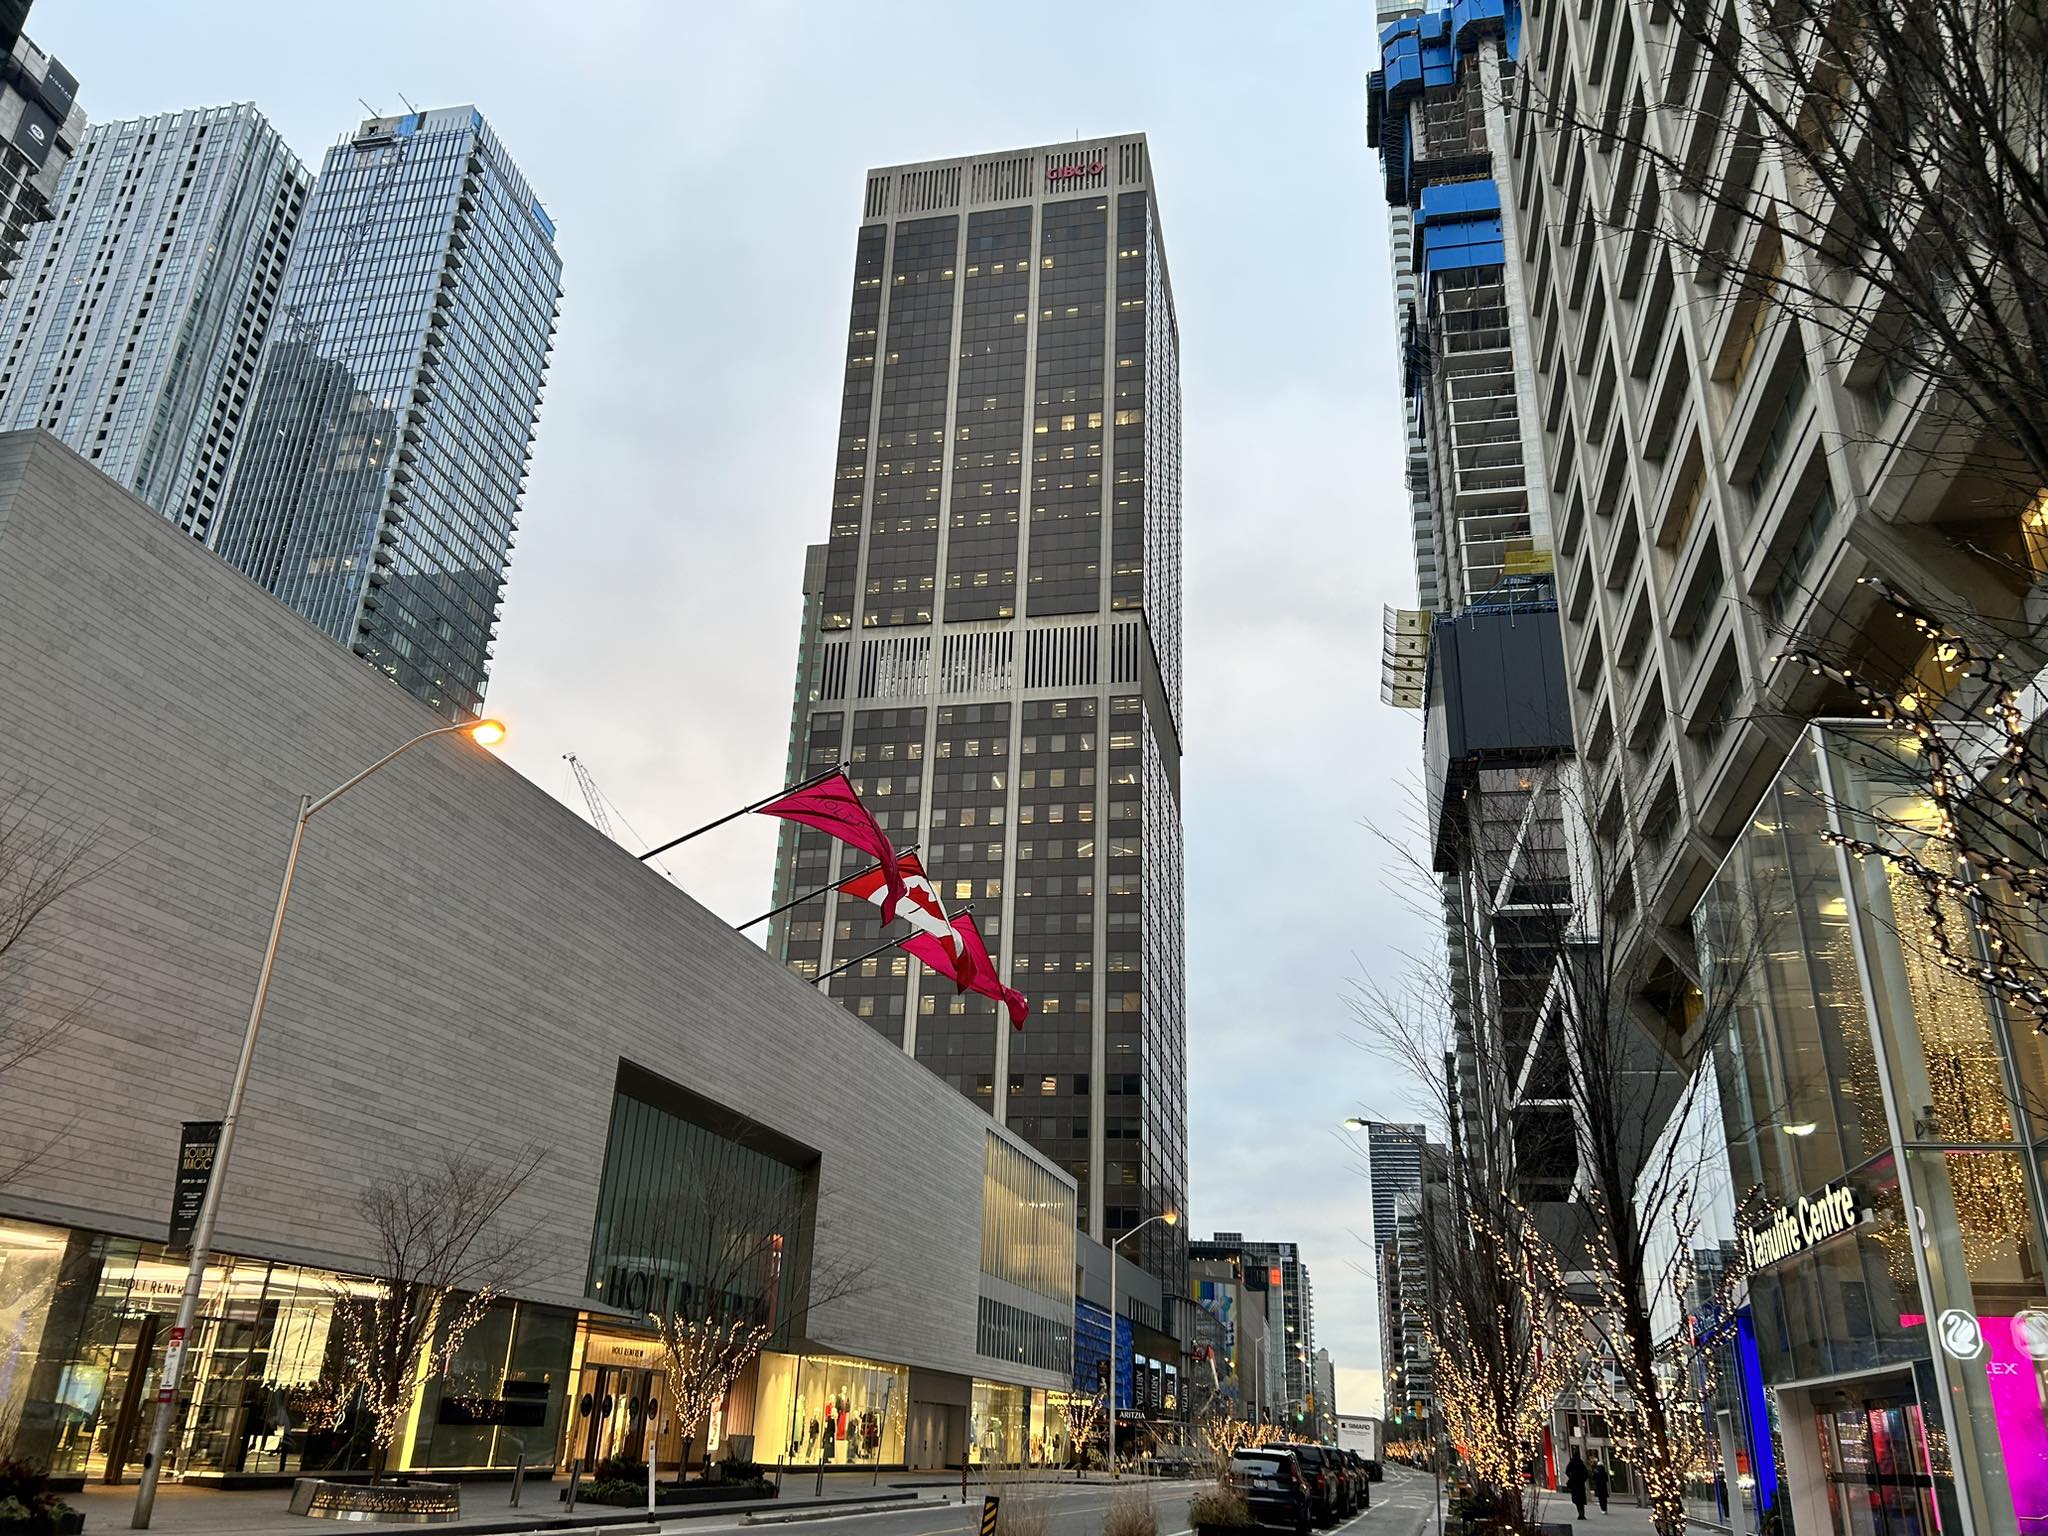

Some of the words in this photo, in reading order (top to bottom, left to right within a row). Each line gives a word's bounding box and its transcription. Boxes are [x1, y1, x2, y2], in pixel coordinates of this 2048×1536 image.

[1047, 164, 1085, 181] CIBC
[182, 1158, 212, 1170] MAGIC
[1798, 1186, 1856, 1245] Centre
[119, 1278, 146, 1292] HOLT
[150, 1280, 185, 1295] RENFR
[607, 1265, 674, 1322] HOLT
[1151, 1374, 1159, 1408] ARITZIA
[1120, 1411, 1146, 1419] ARITZIA
